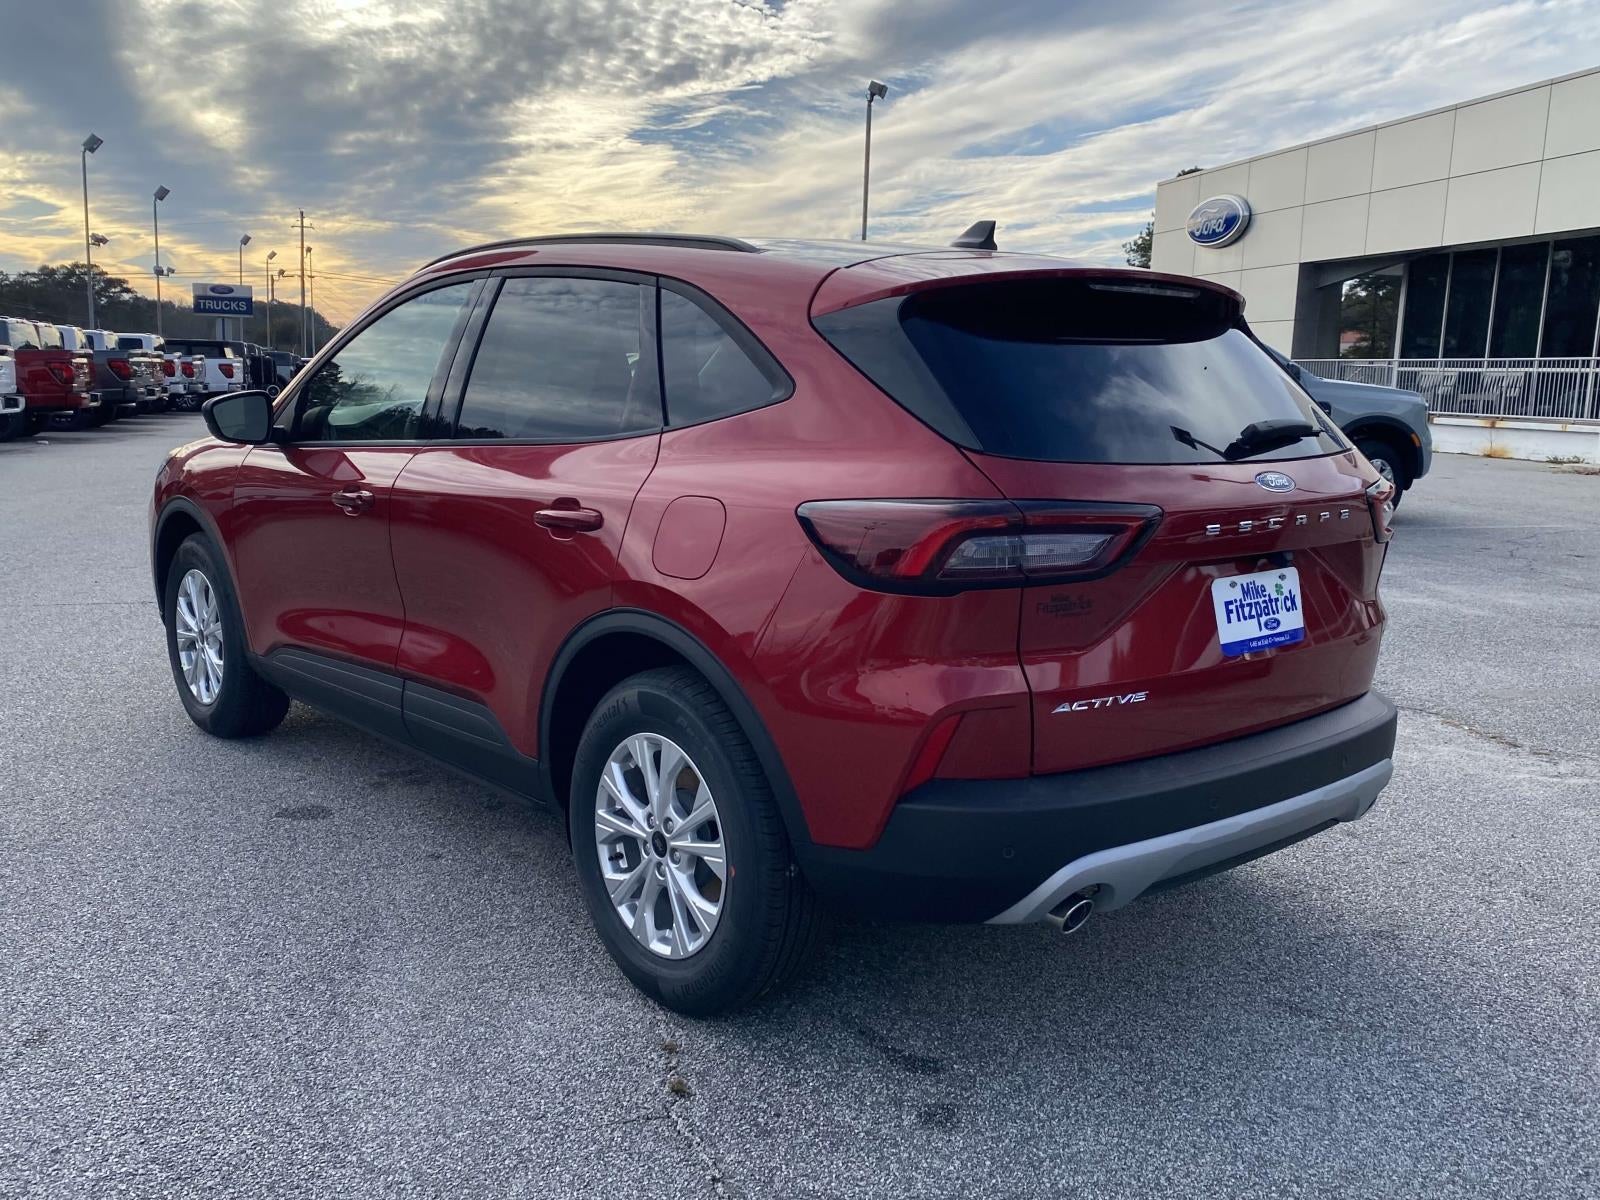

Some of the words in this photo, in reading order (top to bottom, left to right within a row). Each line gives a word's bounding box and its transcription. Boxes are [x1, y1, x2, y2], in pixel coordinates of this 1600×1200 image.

[1193, 208, 1227, 237] Ford
[198, 299, 247, 311] TRUCKS
[1265, 473, 1290, 487] Ford
[1205, 509, 1350, 535] ESCAPE
[1240, 580, 1267, 602] Mike
[1224, 589, 1298, 632] Fitzpatrick
[1050, 690, 1150, 714] ACTIVE
